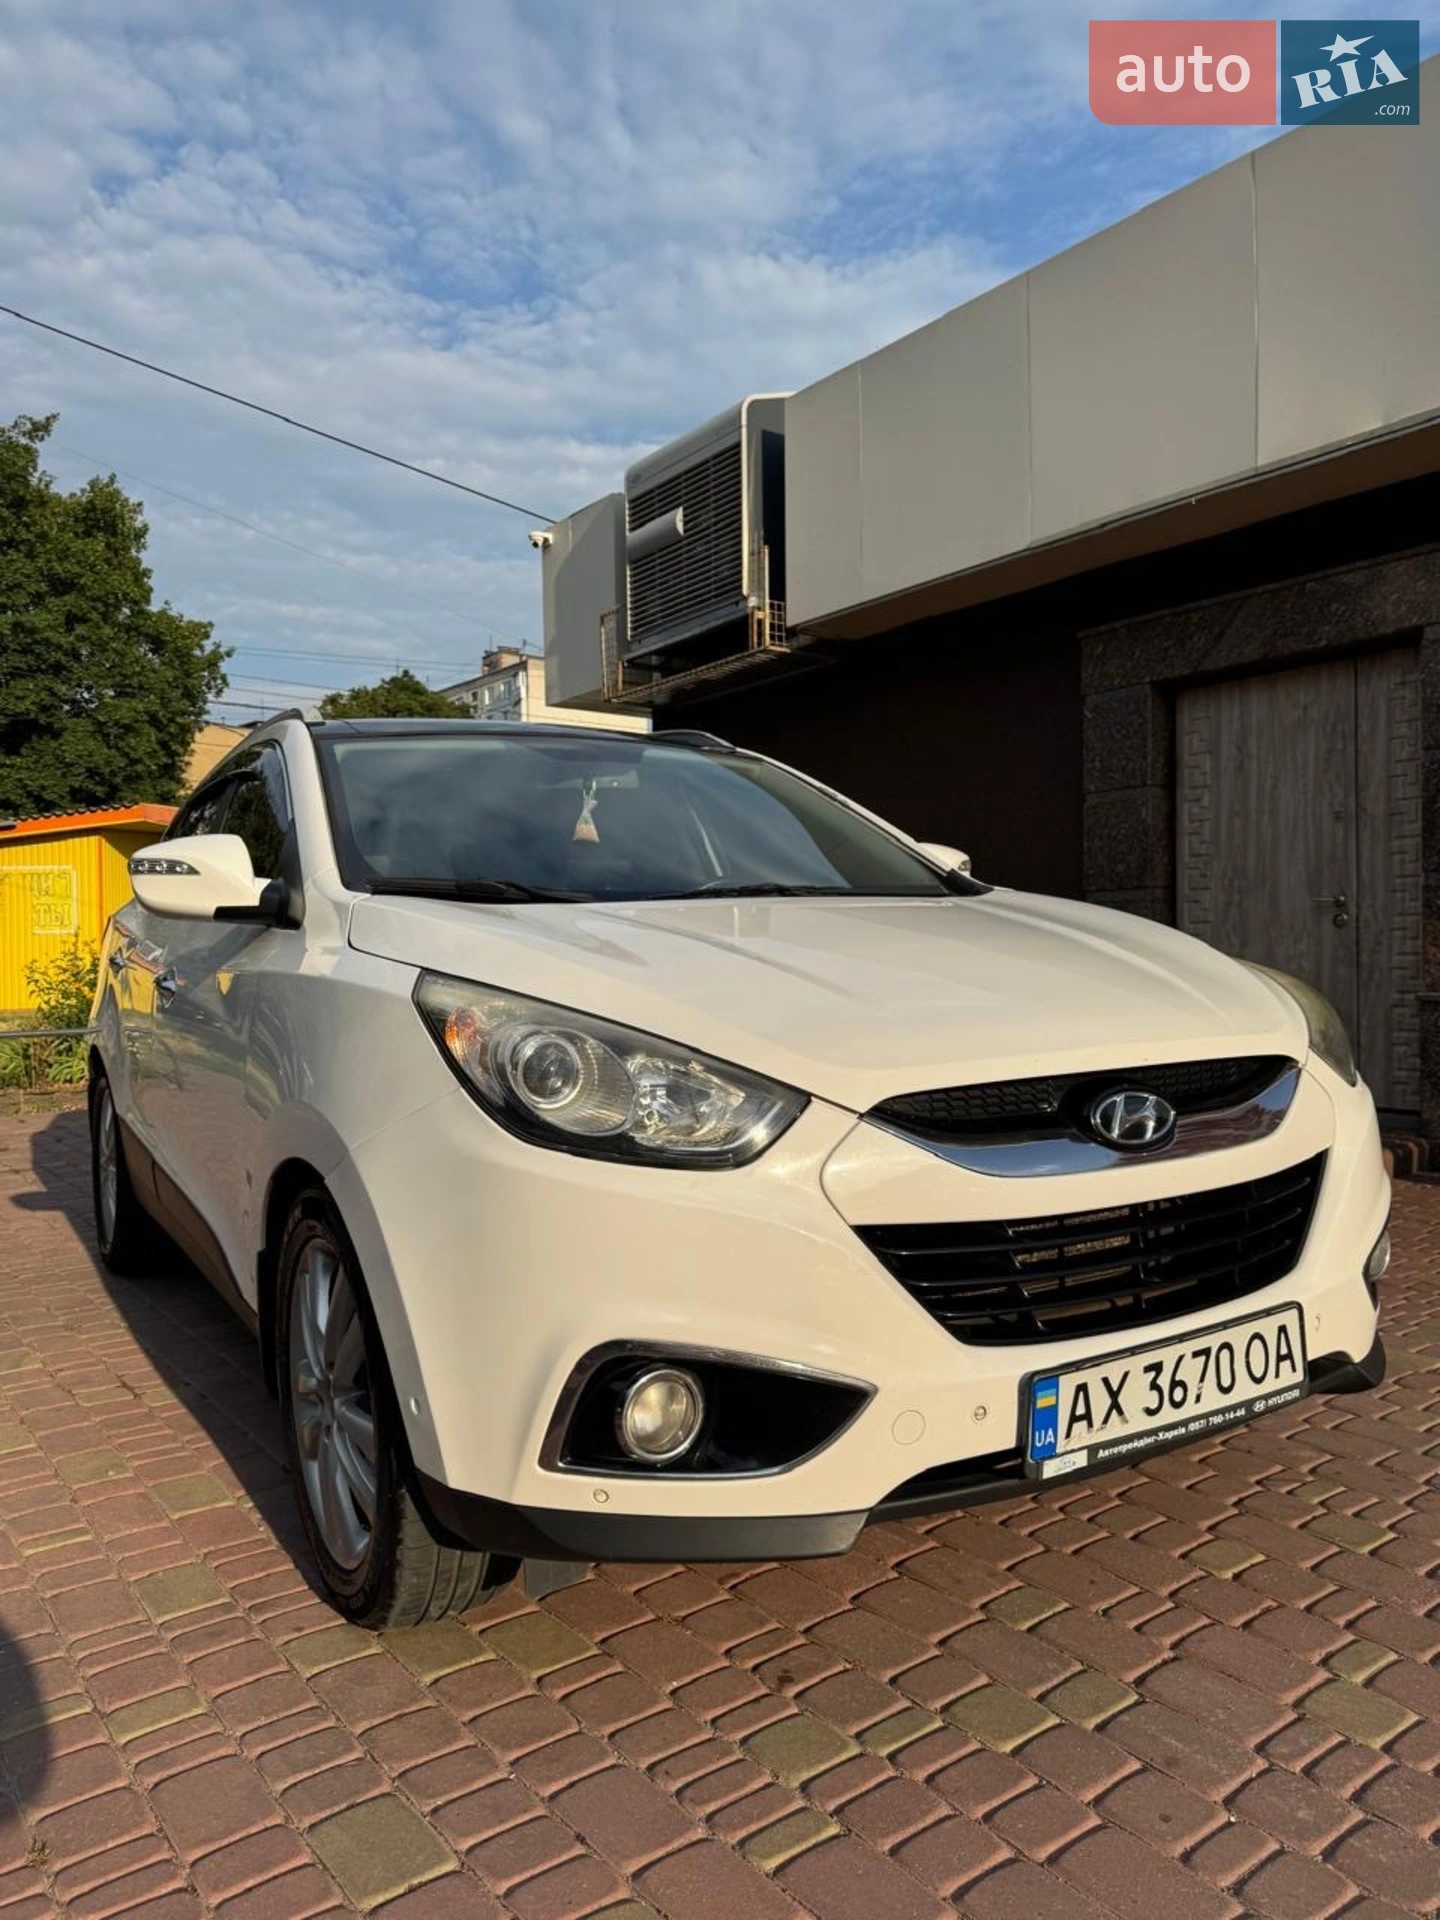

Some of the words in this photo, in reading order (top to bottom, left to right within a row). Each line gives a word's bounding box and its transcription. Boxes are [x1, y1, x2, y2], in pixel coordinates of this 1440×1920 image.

[1064, 1370, 1130, 1440] AX
[1142, 1341, 1236, 1417] 3670
[1244, 1324, 1297, 1384] OA
[1267, 1388, 1300, 1407] HYUNDAI
[1035, 1428, 1056, 1448] UA
